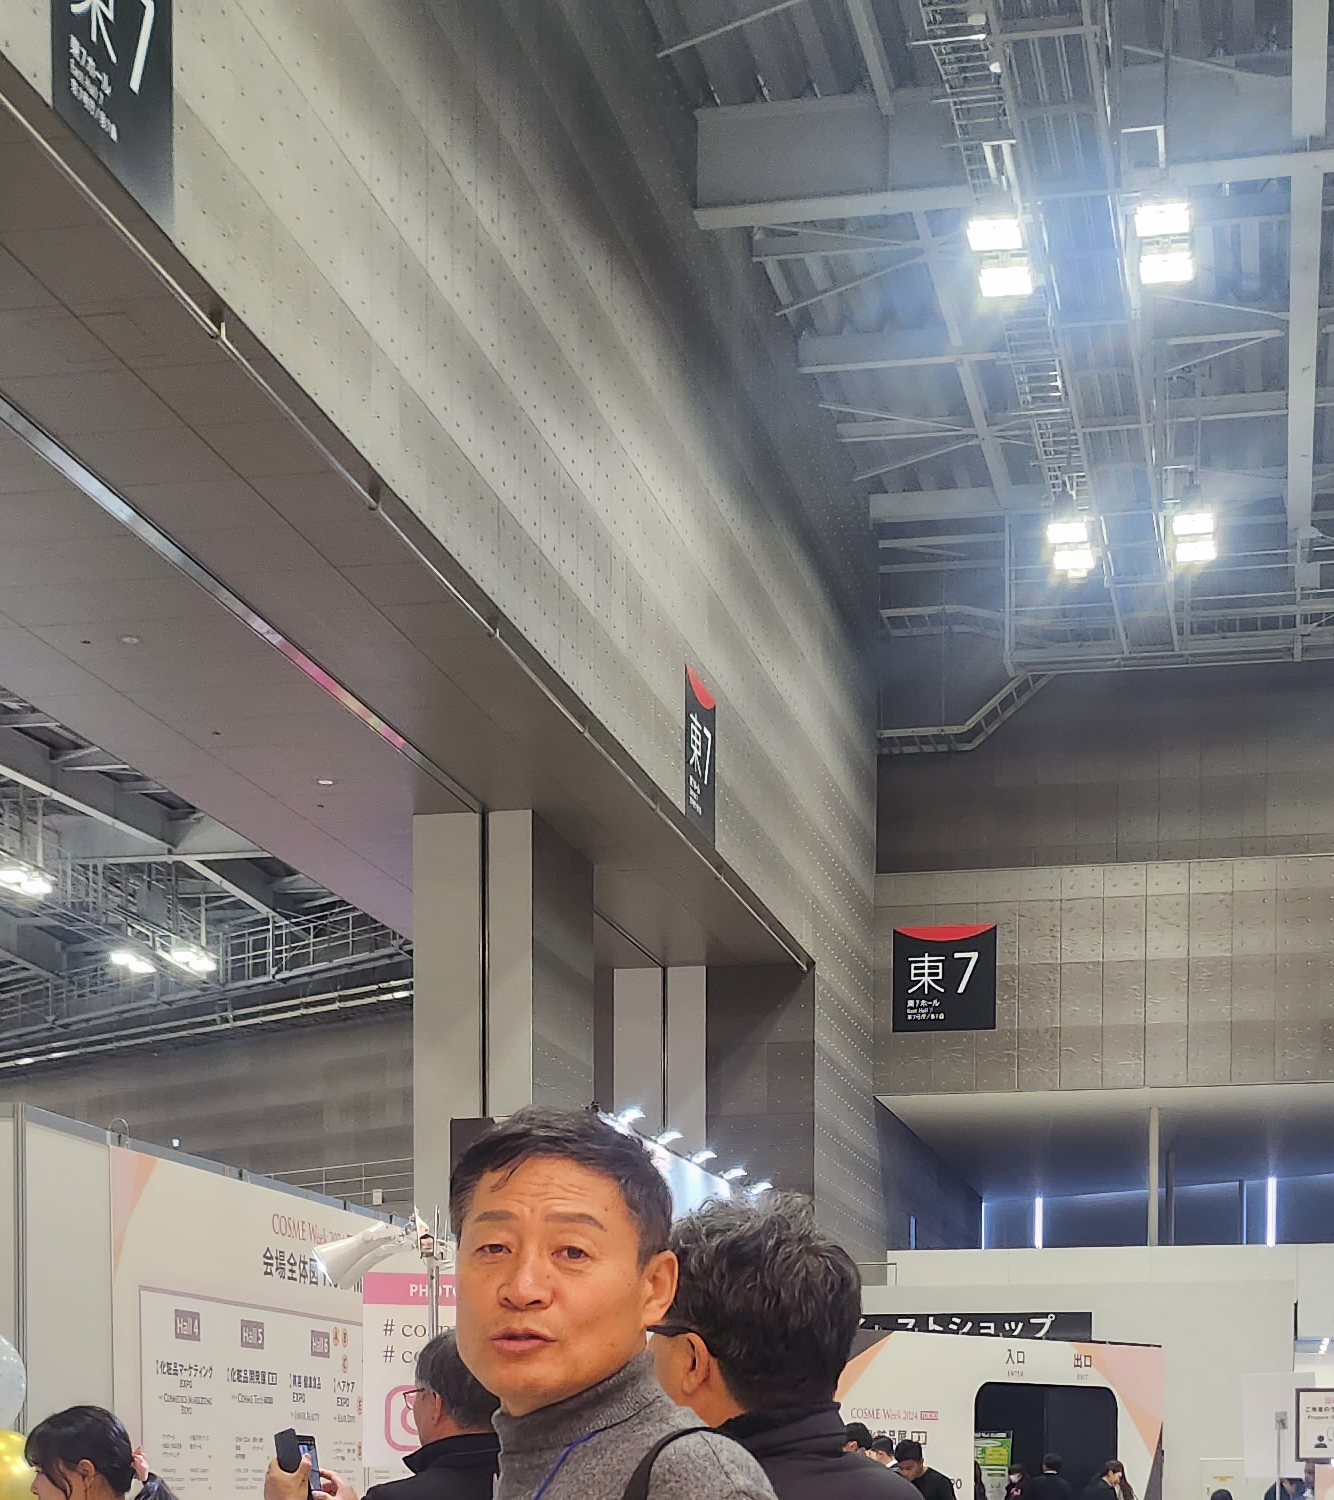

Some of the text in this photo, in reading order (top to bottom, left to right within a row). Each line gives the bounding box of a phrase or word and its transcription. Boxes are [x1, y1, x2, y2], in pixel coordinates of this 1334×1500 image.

[689, 712, 712, 785] 東7
[907, 951, 979, 995] 東7
[272, 1213, 306, 1241] COSME
[308, 1222, 327, 1245] Week
[262, 1247, 320, 1287] 会場全体図
[176, 1316, 199, 1336] Hall 4
[242, 1326, 263, 1344] Hall 5
[312, 1336, 329, 1353] Hall 6
[1005, 1349, 1026, 1365] 入口
[1073, 1353, 1093, 1369] 出口
[336, 1380, 356, 1393] ヘアケア
[292, 1392, 306, 1403] EXPO
[336, 1396, 350, 1408] EXPO
[851, 1407, 881, 1420] COSME
[883, 1409, 902, 1420] Week
[903, 1410, 918, 1421] 2024
